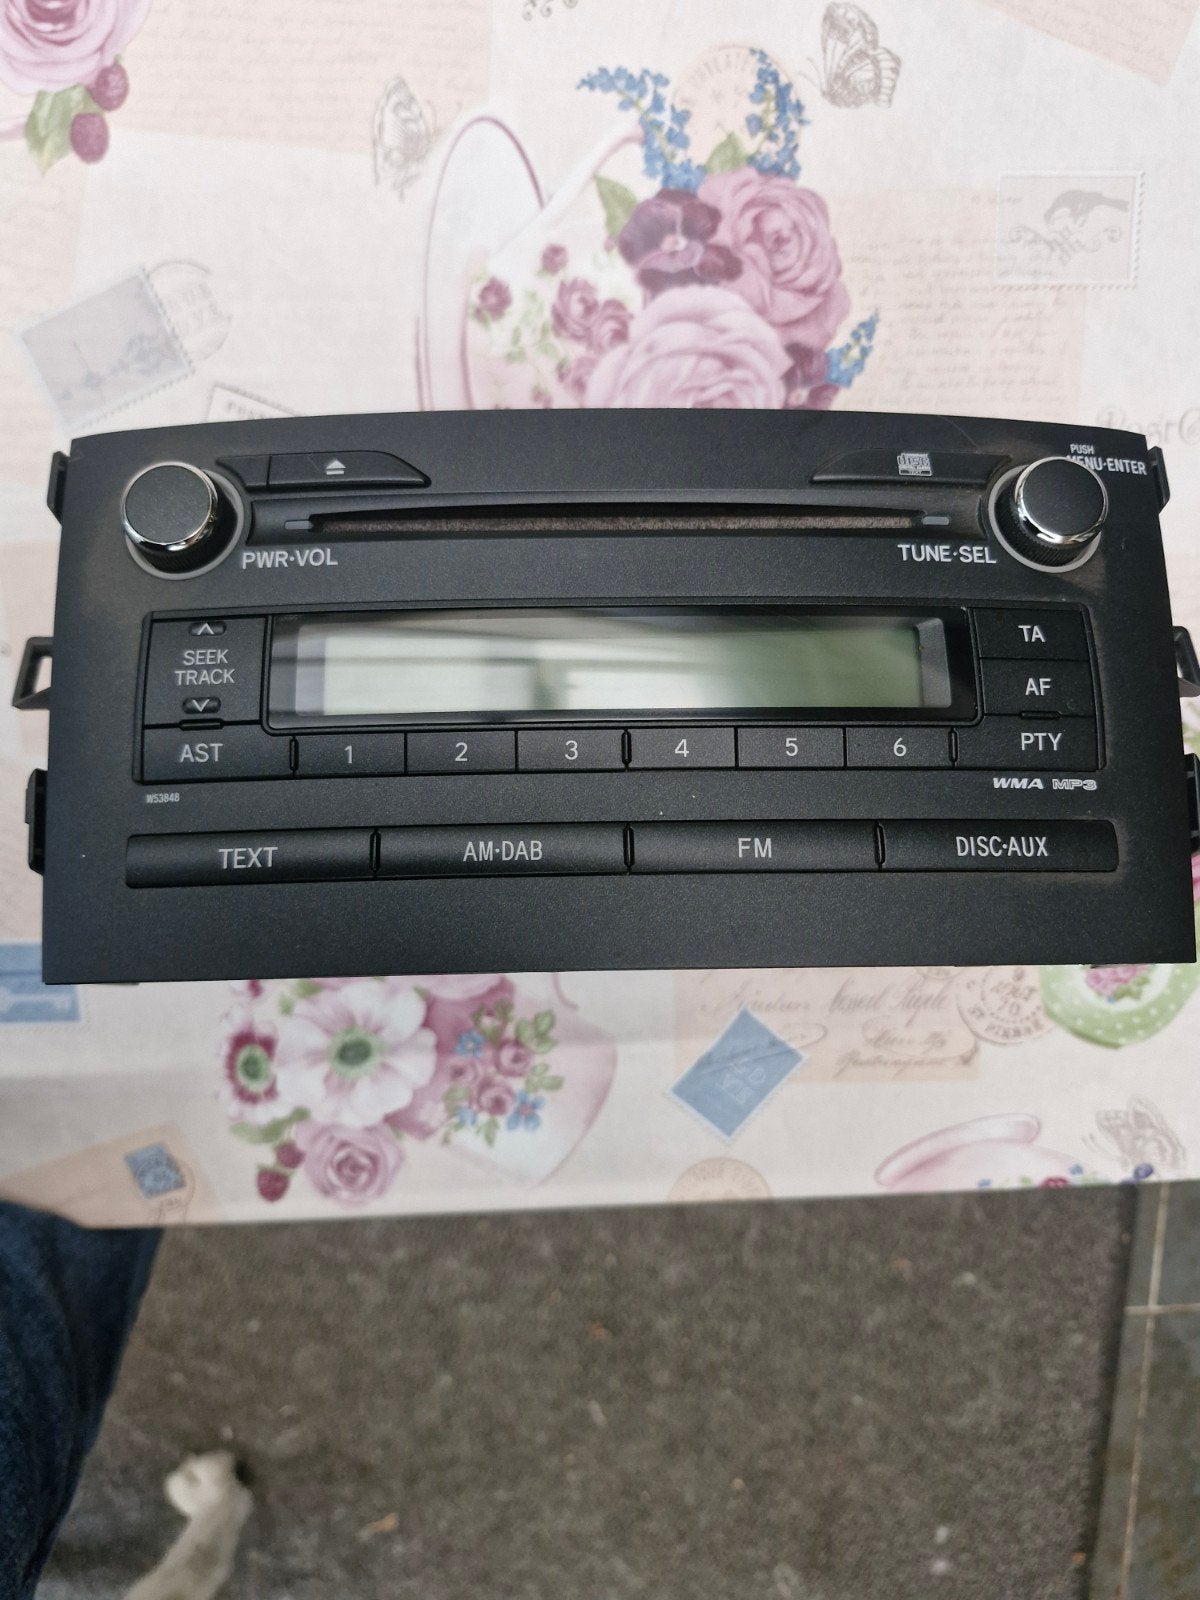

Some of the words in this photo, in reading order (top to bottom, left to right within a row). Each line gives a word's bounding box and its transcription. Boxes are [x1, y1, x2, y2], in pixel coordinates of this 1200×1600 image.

[1069, 443, 1095, 455] PUSH
[1018, 624, 1046, 643] TA
[183, 649, 229, 666] SEEK
[174, 669, 235, 686] TRACK
[1025, 677, 1052, 696] AF
[454, 742, 469, 762] 2
[564, 740, 579, 760] 3
[674, 738, 690, 758] 4
[785, 737, 799, 757] 5
[893, 737, 907, 757] 6
[1020, 732, 1063, 752] PTY
[179, 743, 223, 763] AST
[344, 745, 354, 764] 1
[993, 777, 1044, 790] WMA
[1051, 778, 1098, 791] MP3
[737, 837, 773, 858] FM
[218, 847, 279, 870] TEXT
